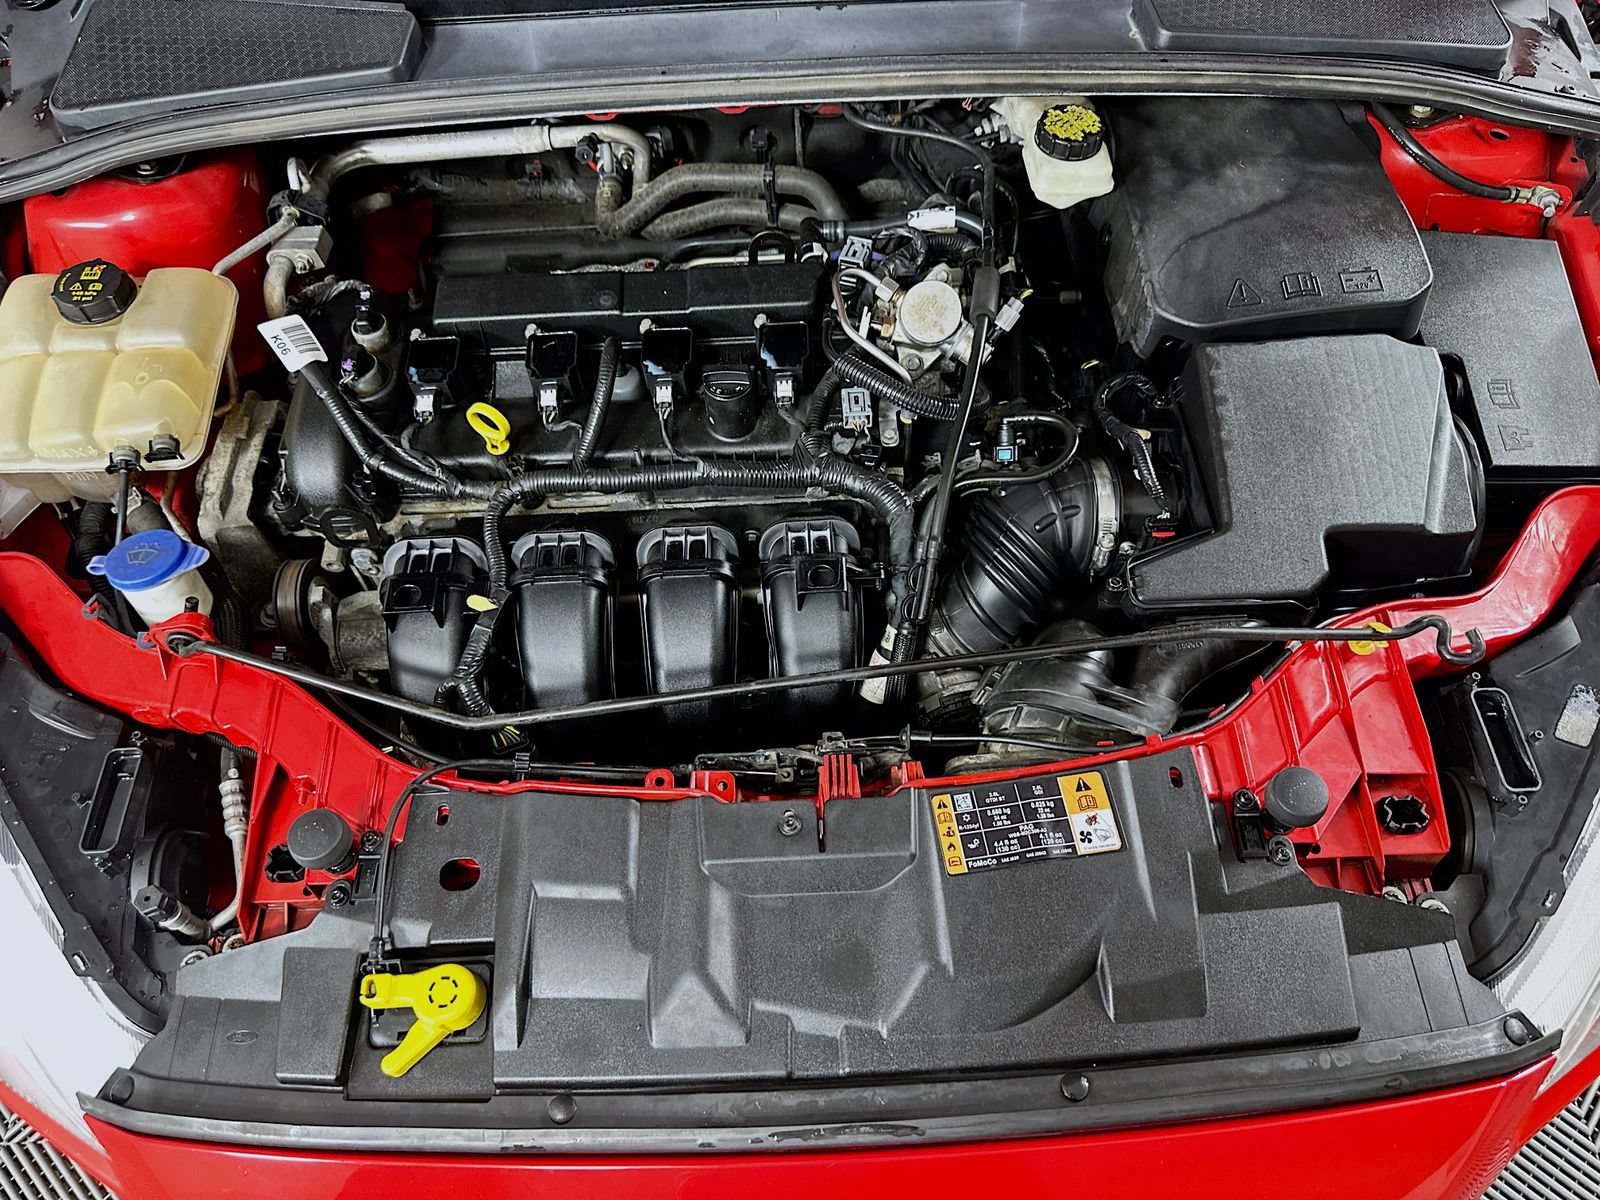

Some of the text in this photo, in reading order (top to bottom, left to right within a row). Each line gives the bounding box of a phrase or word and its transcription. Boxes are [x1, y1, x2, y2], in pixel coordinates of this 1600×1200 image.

[271, 335, 291, 355] K06
[1019, 824, 1034, 832] PAG
[968, 858, 997, 868] FoMoCo
